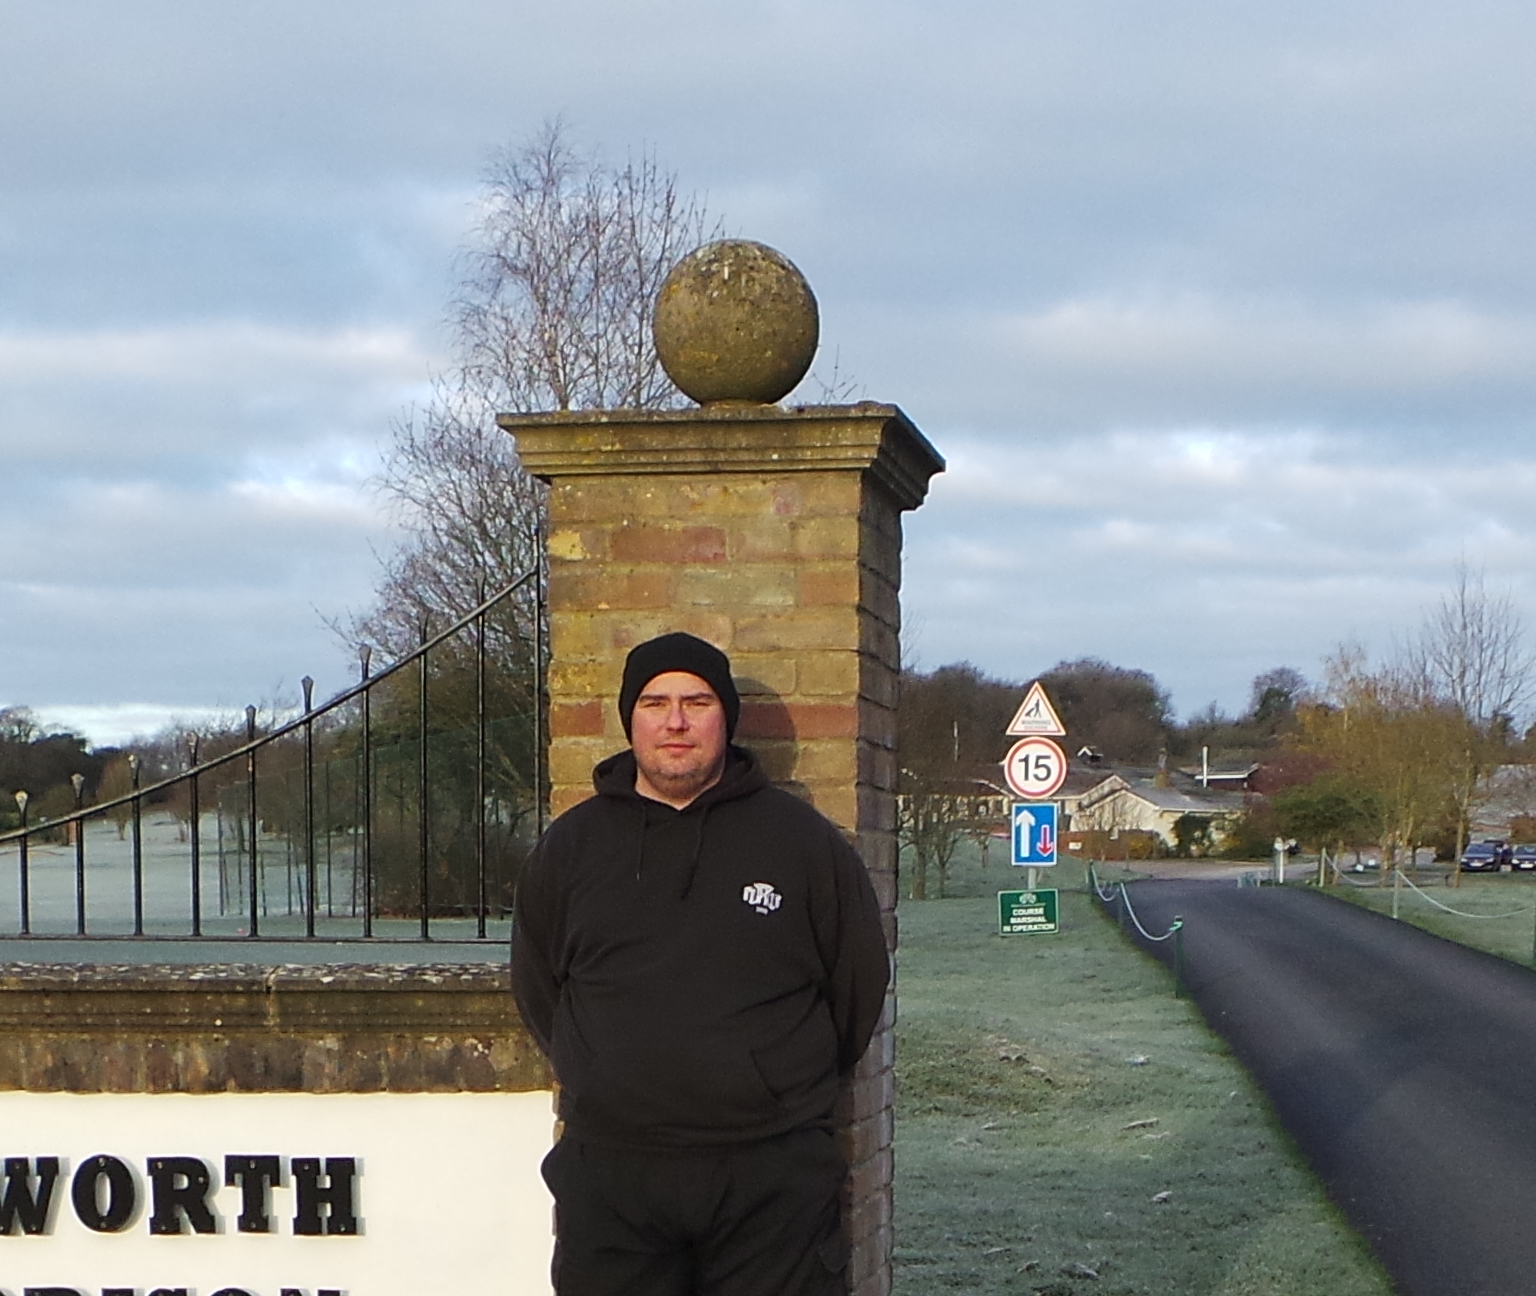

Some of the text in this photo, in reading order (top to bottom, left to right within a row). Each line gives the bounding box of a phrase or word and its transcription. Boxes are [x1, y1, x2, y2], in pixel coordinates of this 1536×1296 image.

[1018, 754, 1052, 782] 15
[1012, 907, 1044, 916] COURSE
[1010, 916, 1047, 924] MARSHAL
[1012, 923, 1055, 932] OPERATION
